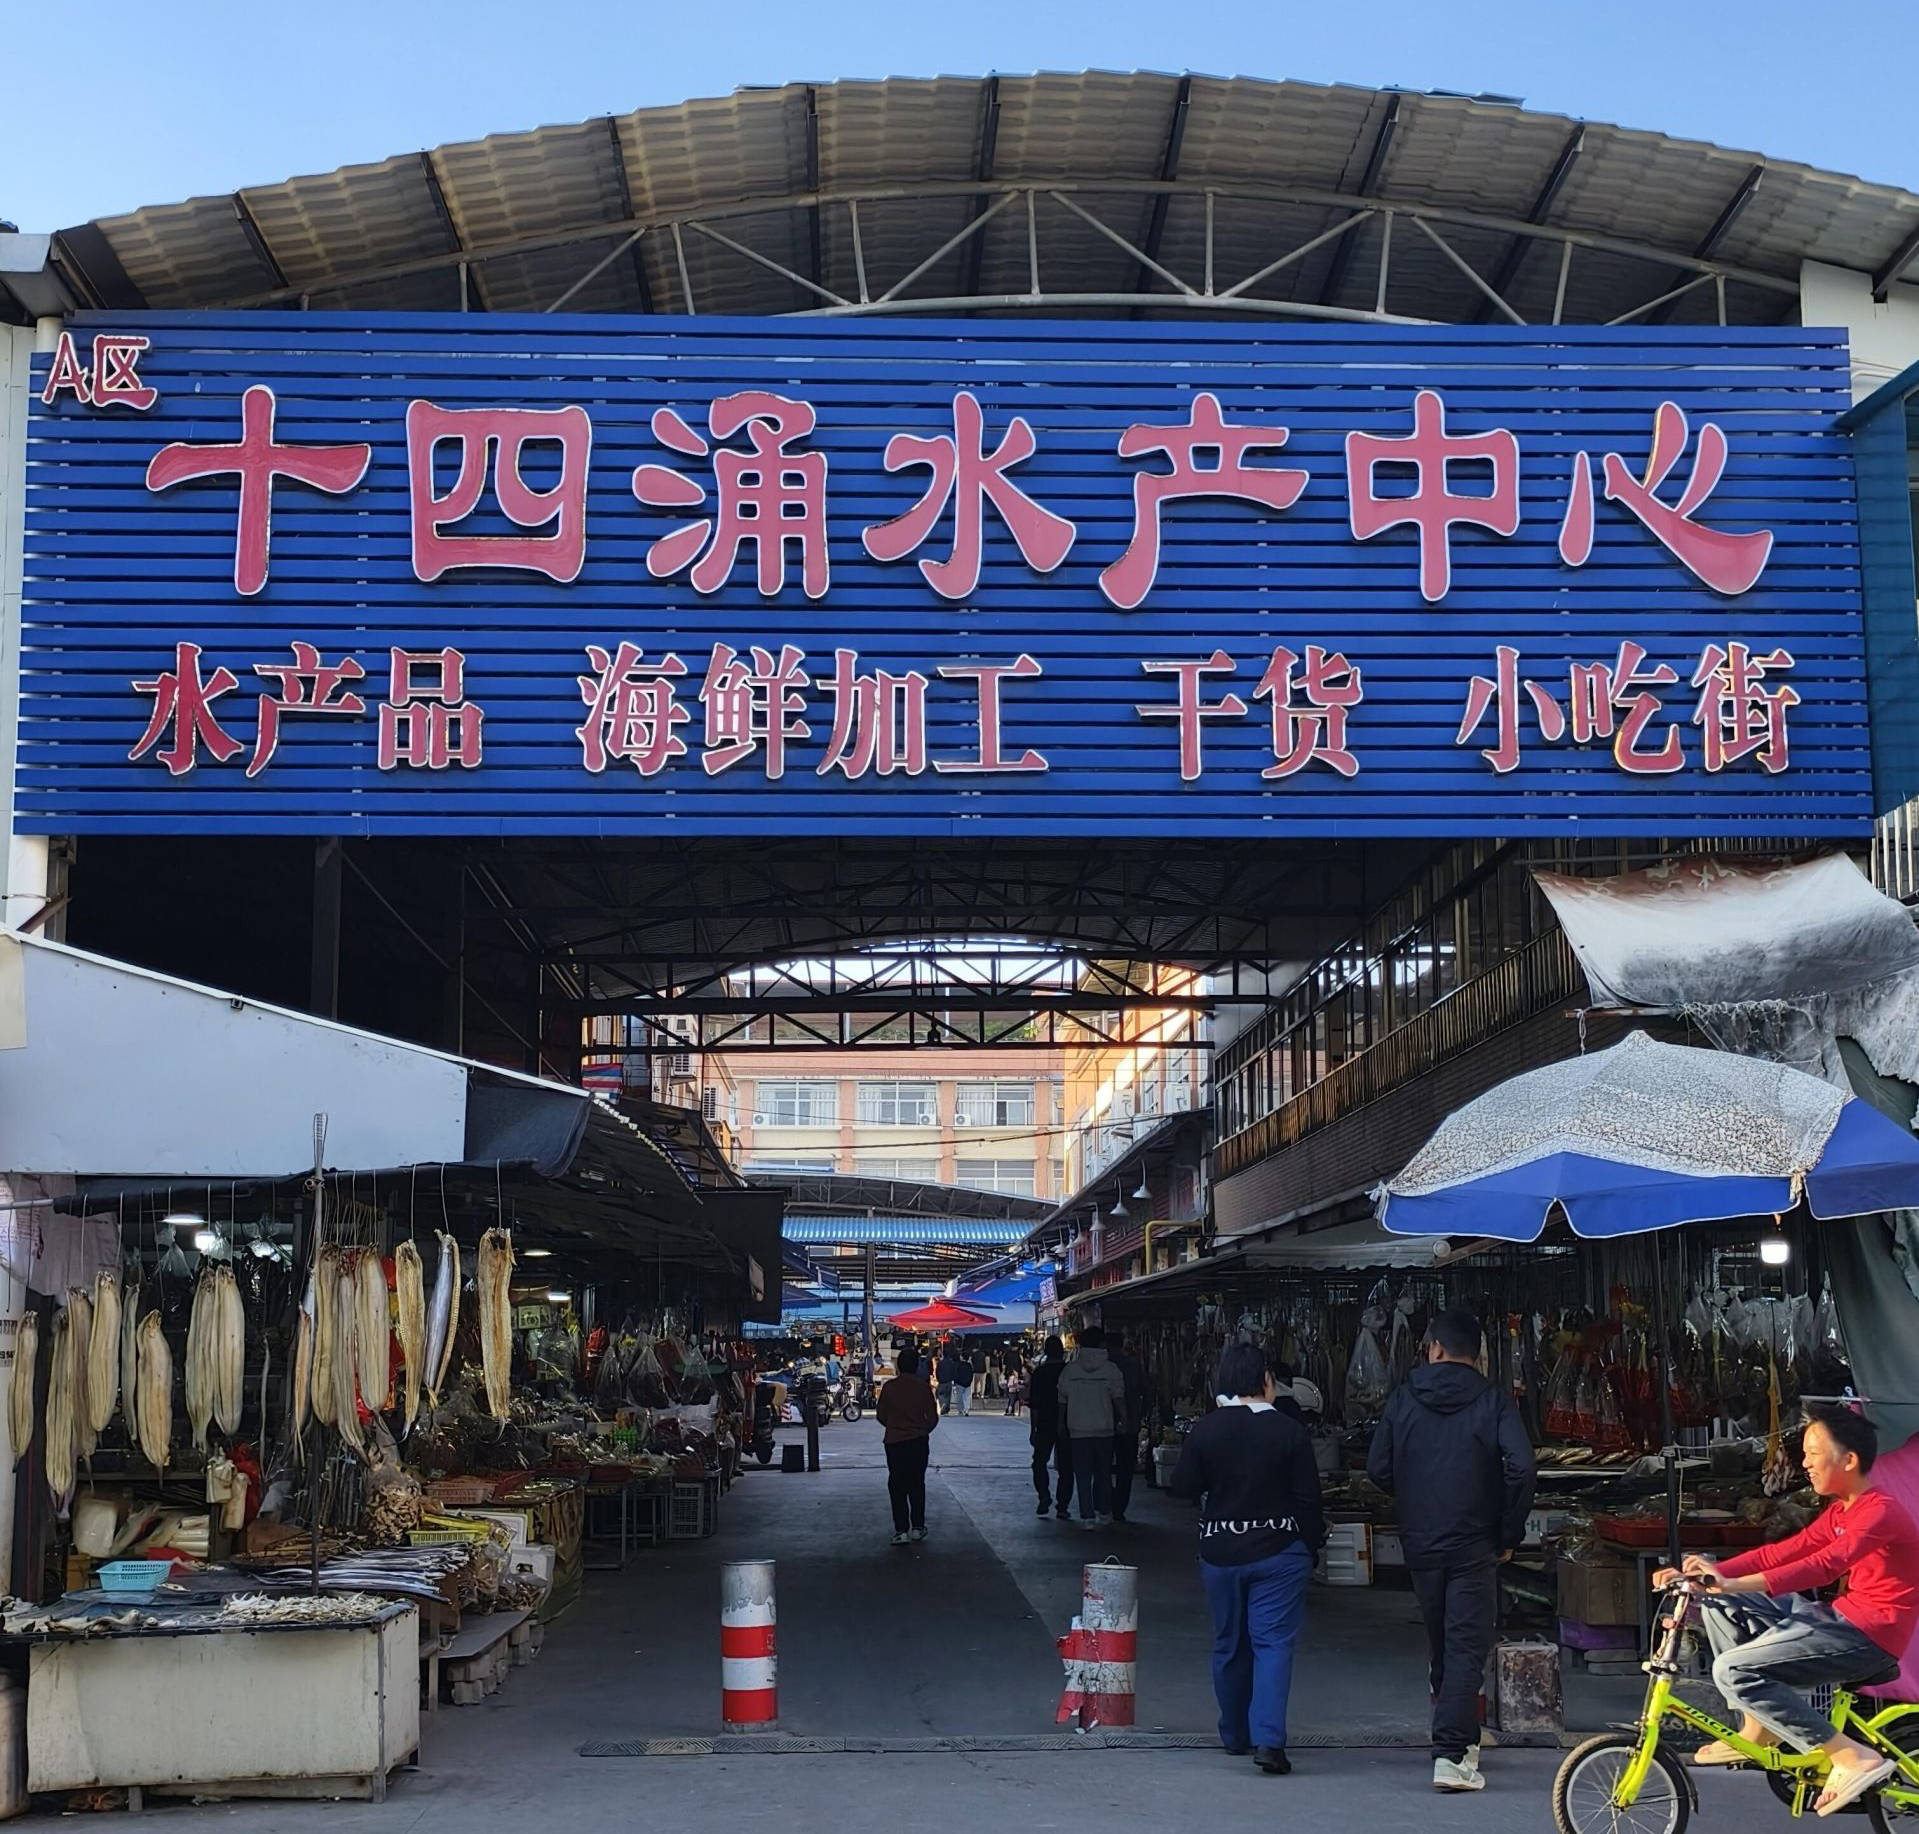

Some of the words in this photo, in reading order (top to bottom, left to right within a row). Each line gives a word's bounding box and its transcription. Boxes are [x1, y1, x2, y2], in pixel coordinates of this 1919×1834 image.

[41, 331, 158, 410] A区
[145, 384, 1774, 609] 十四涌水产中心
[128, 641, 484, 778] 水产品
[575, 641, 1049, 780] 海鲜加工
[1135, 644, 1364, 781] 干货
[1457, 641, 1801, 775] 小吃街
